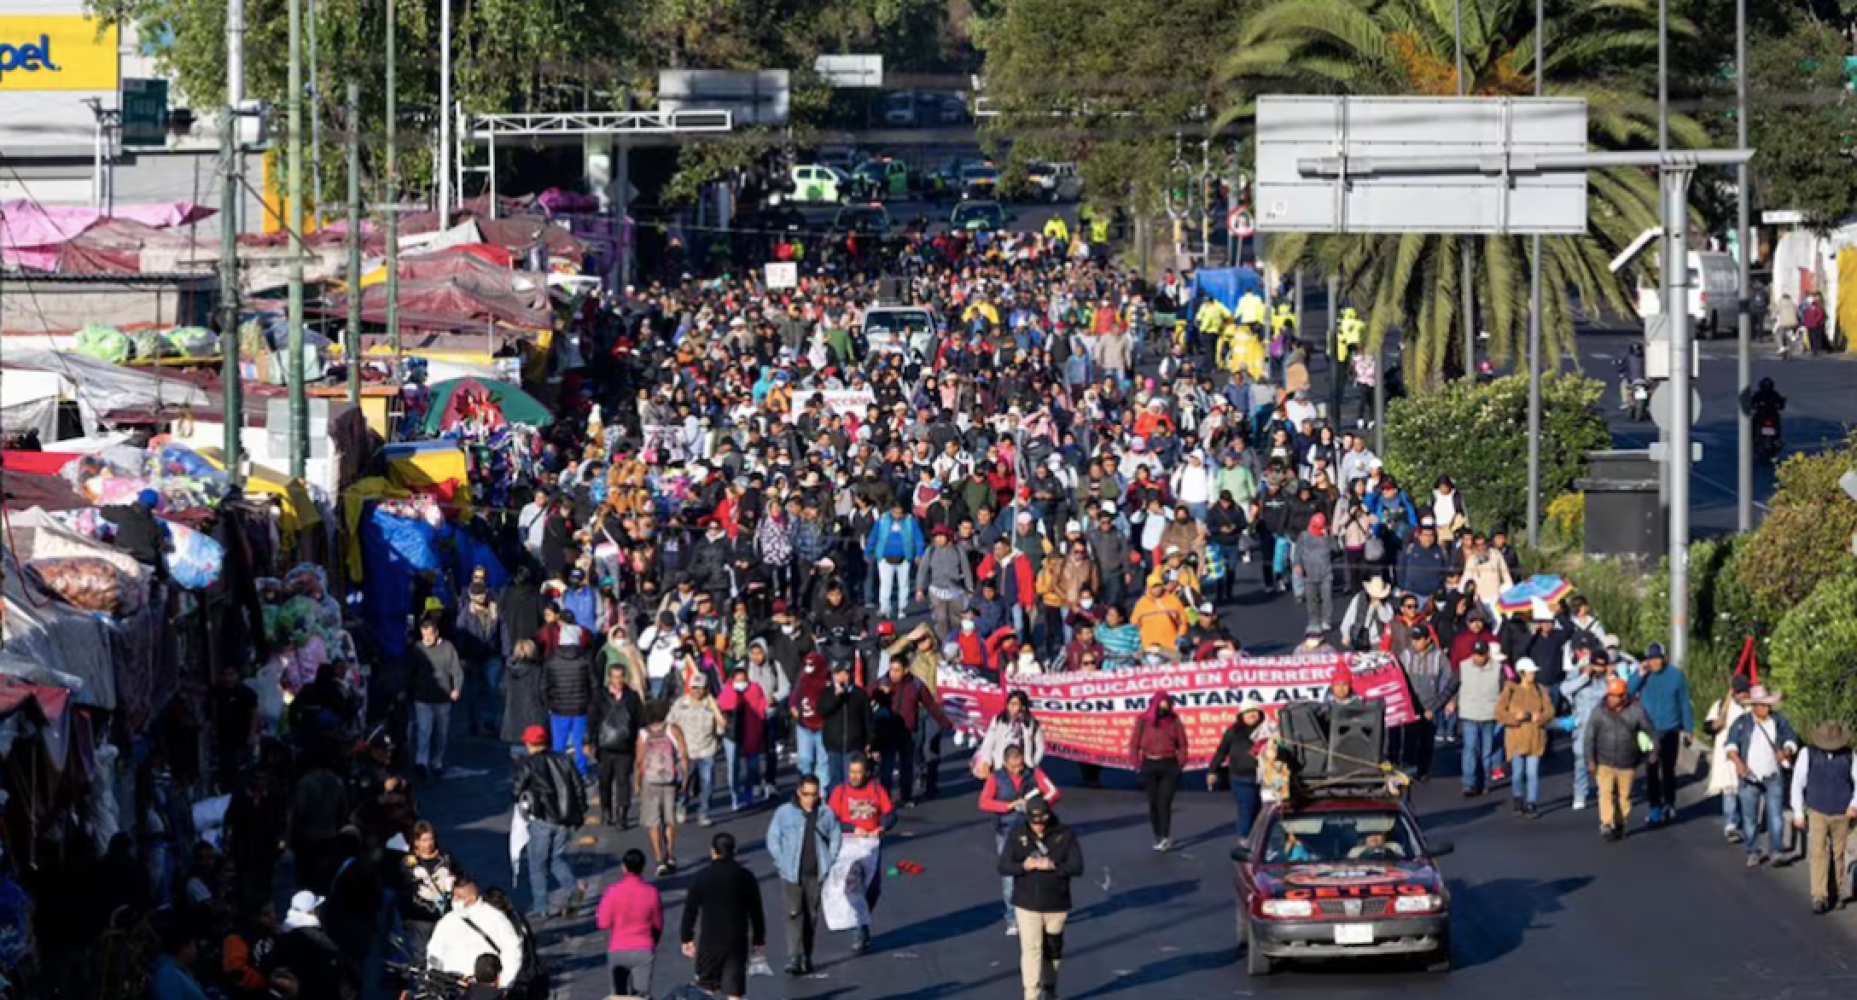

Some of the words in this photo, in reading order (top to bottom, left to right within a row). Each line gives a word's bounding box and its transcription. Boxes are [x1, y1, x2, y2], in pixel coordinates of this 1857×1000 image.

[1038, 685, 1063, 697] LA
[1070, 674, 1188, 697] EDUCACIÓN
[1194, 672, 1222, 686] EN
[1028, 696, 1115, 712] EGIÓN
[1124, 685, 1265, 711] MNTAÑA
[1273, 685, 1330, 703] ALT
[1285, 884, 1426, 900] CETEG
